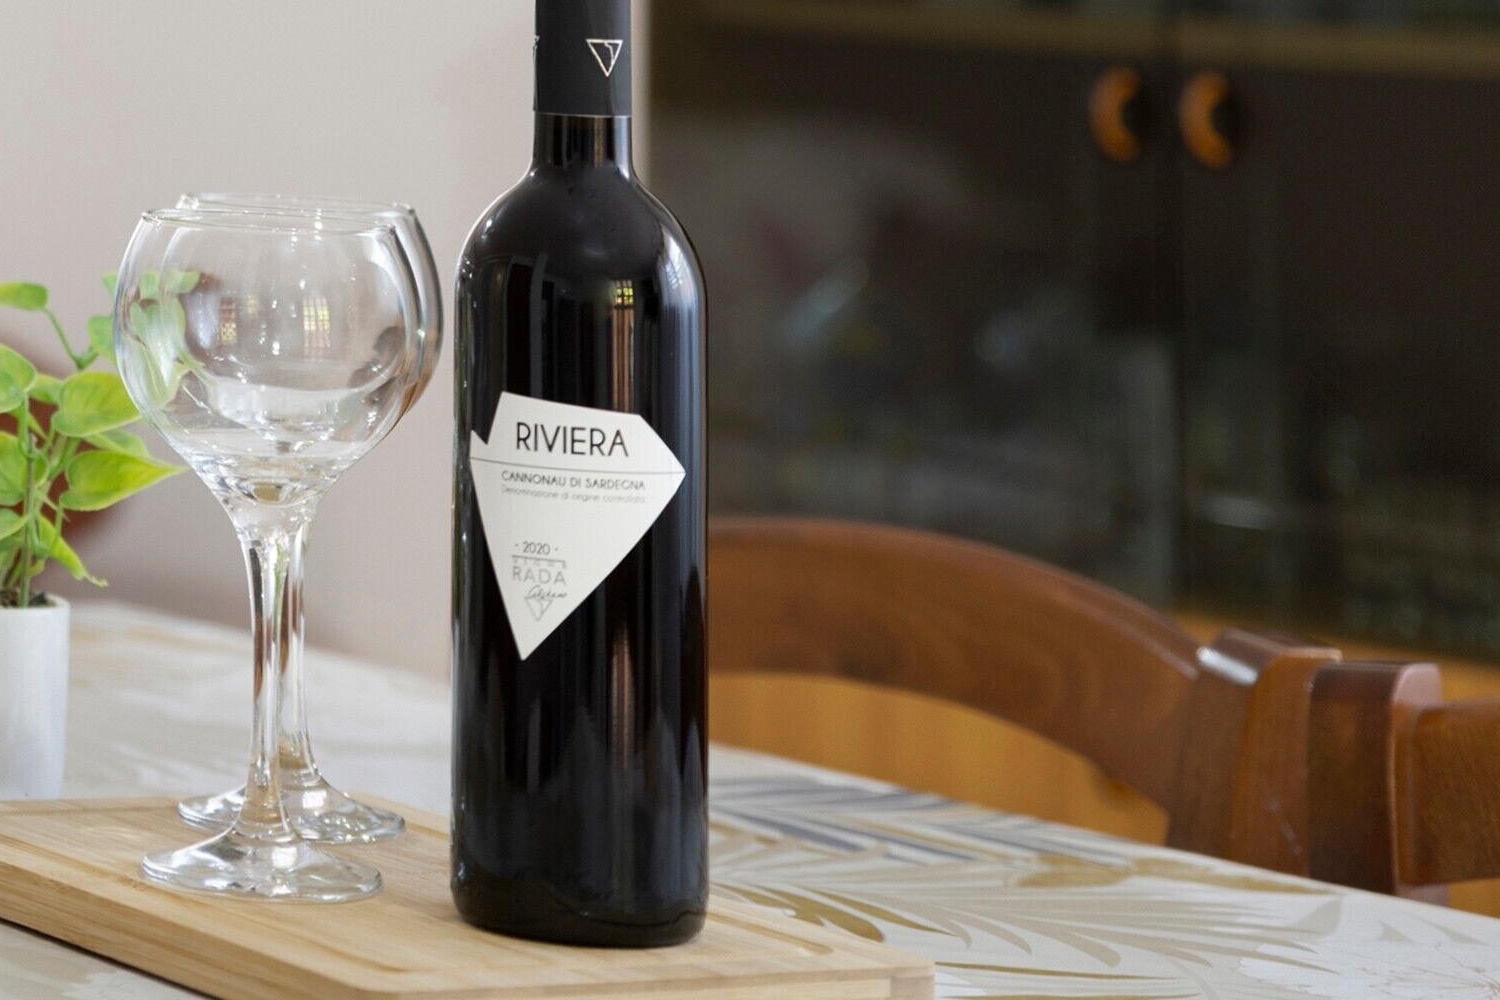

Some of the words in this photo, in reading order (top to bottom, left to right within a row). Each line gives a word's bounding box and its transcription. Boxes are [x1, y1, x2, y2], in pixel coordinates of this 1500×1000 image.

[516, 421, 629, 457] RIVIERA
[501, 470, 566, 487] CANNONAU
[570, 476, 582, 488] DI
[586, 478, 645, 491] SARDEGNA
[522, 540, 551, 555] 2020
[512, 566, 567, 586] RADA
